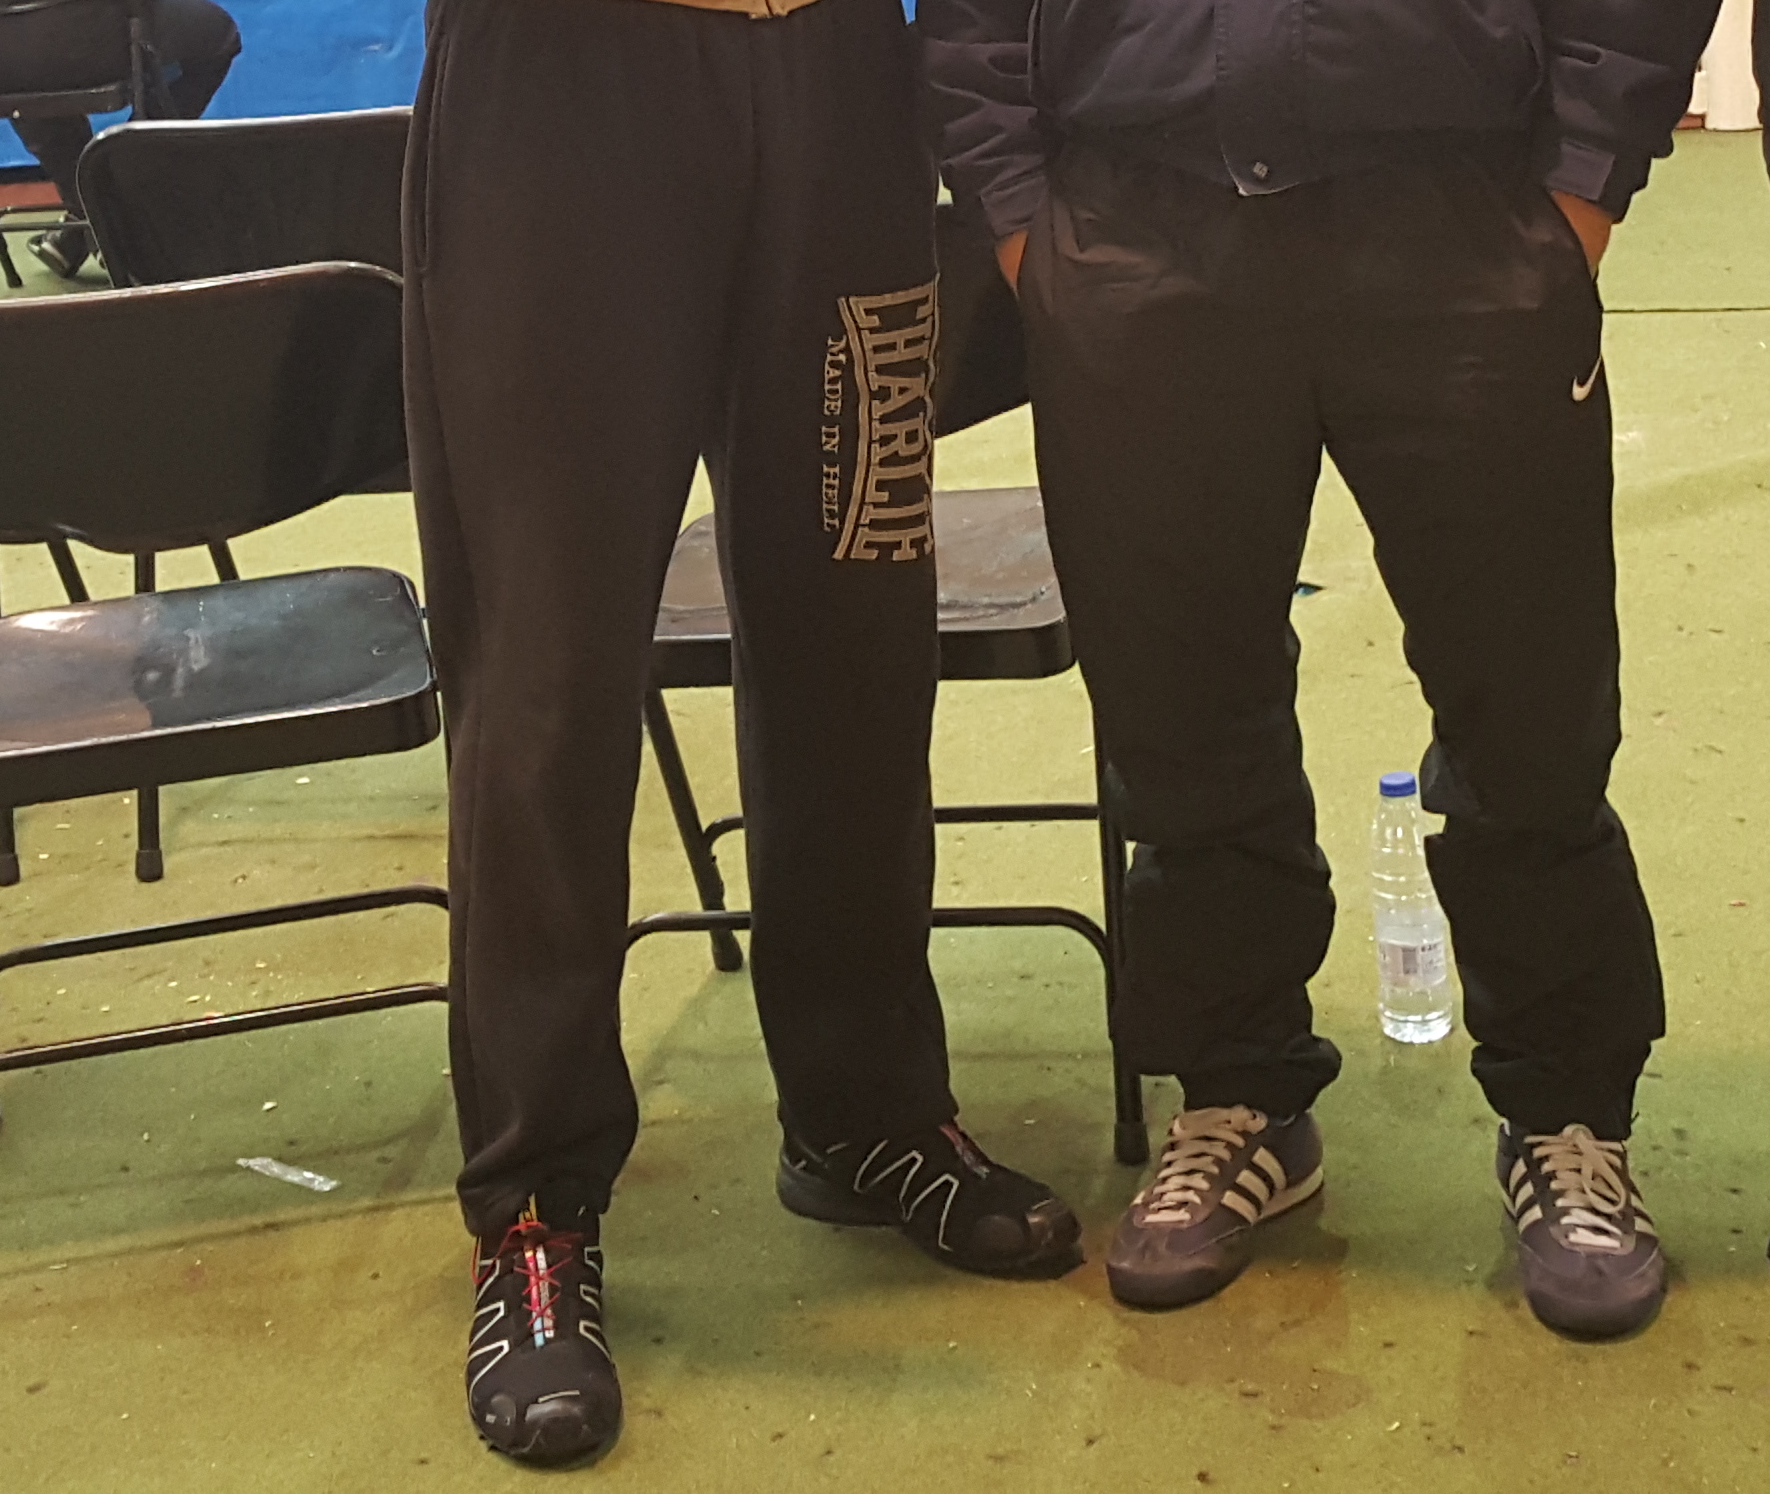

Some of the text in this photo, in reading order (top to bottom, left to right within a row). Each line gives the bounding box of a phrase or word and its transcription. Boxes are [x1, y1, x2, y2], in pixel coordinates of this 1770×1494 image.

[821, 335, 847, 533] MADE IN HELL
[849, 281, 936, 562] CHARLIE
